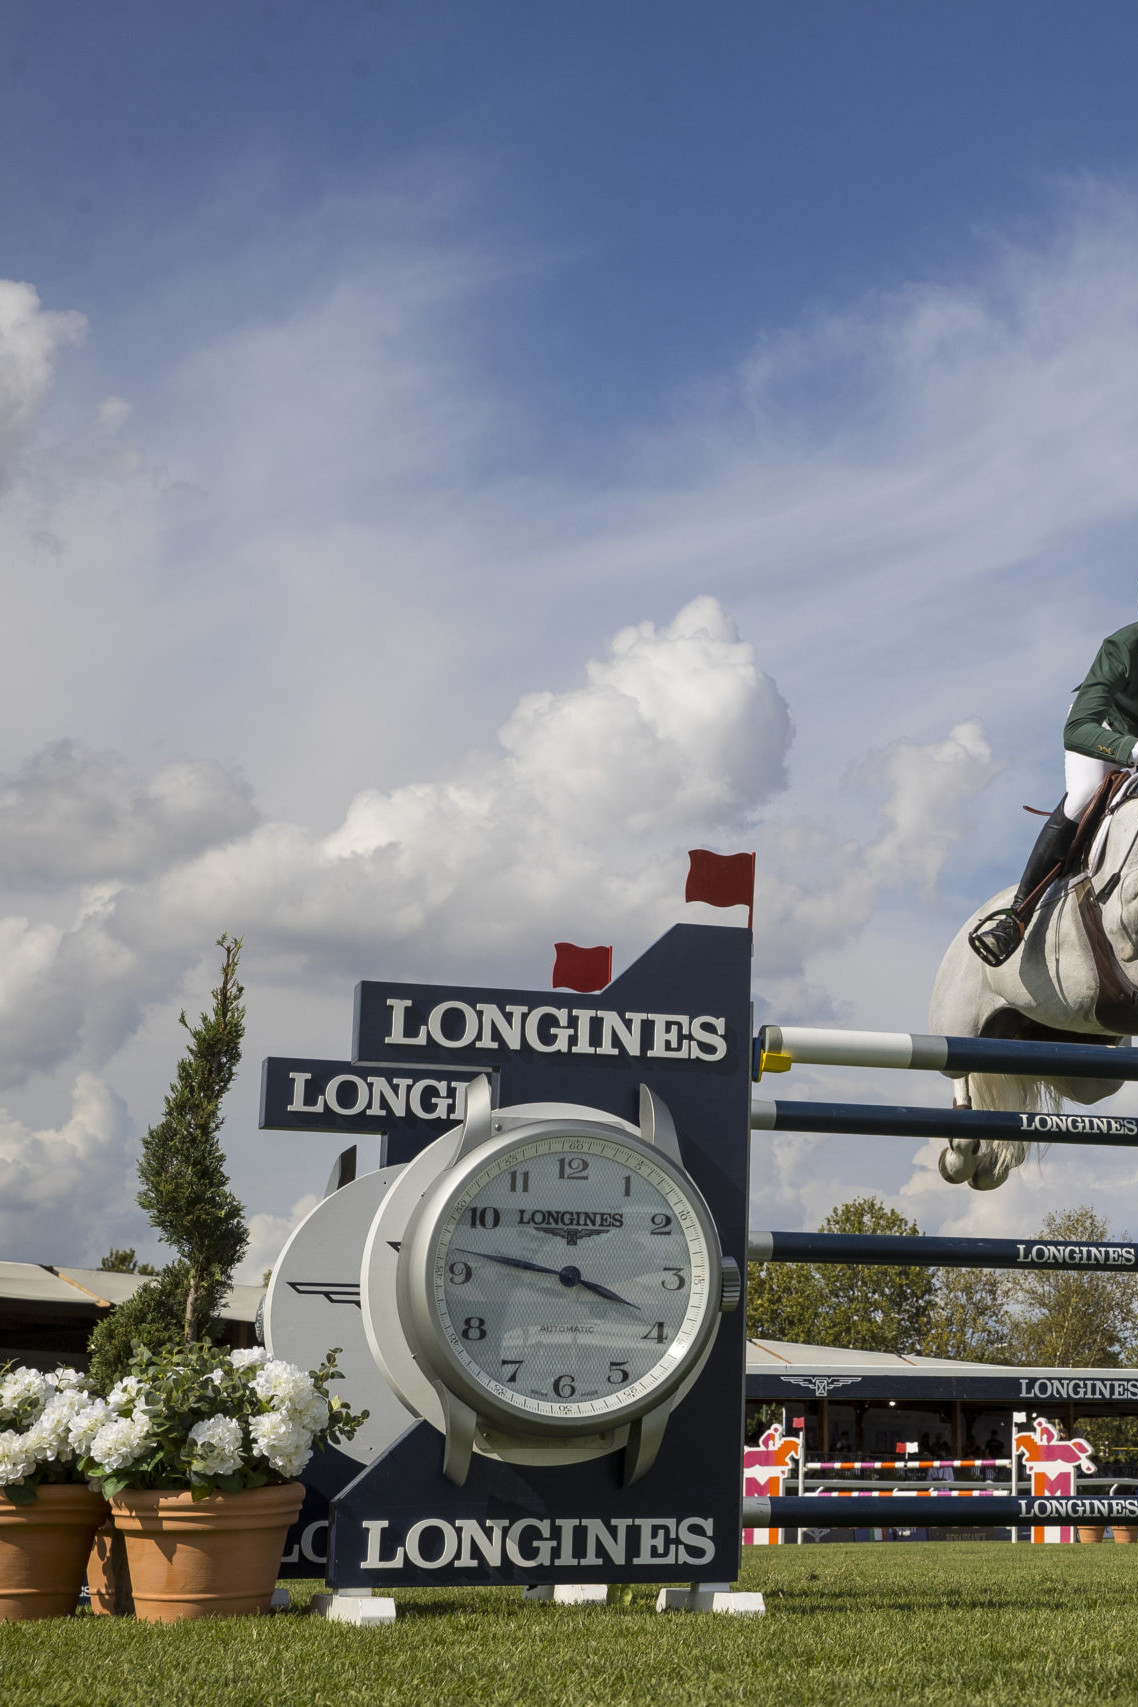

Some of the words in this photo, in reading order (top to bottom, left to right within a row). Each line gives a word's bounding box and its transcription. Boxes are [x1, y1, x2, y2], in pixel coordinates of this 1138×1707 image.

[386, 998, 727, 1062] LONGINES
[287, 1072, 467, 1121] LONGI
[1019, 1113, 1138, 1136] LONGINES
[558, 1158, 589, 1180] 12
[508, 1170, 529, 1192] 11
[623, 1175, 631, 1197] 1
[469, 1207, 500, 1230] 10
[518, 1209, 624, 1228] LONGINES
[650, 1213, 672, 1235] 2
[1016, 1243, 1137, 1266] LONGINES
[449, 1261, 473, 1285] 9
[661, 1267, 686, 1291] 3
[461, 1316, 487, 1341] 8
[539, 1325, 595, 1333] AUTOMATIC
[640, 1321, 668, 1344] 4
[501, 1359, 524, 1383] 7
[607, 1360, 629, 1384] 5
[552, 1374, 576, 1398] 6
[360, 1516, 716, 1570] LONGINES
